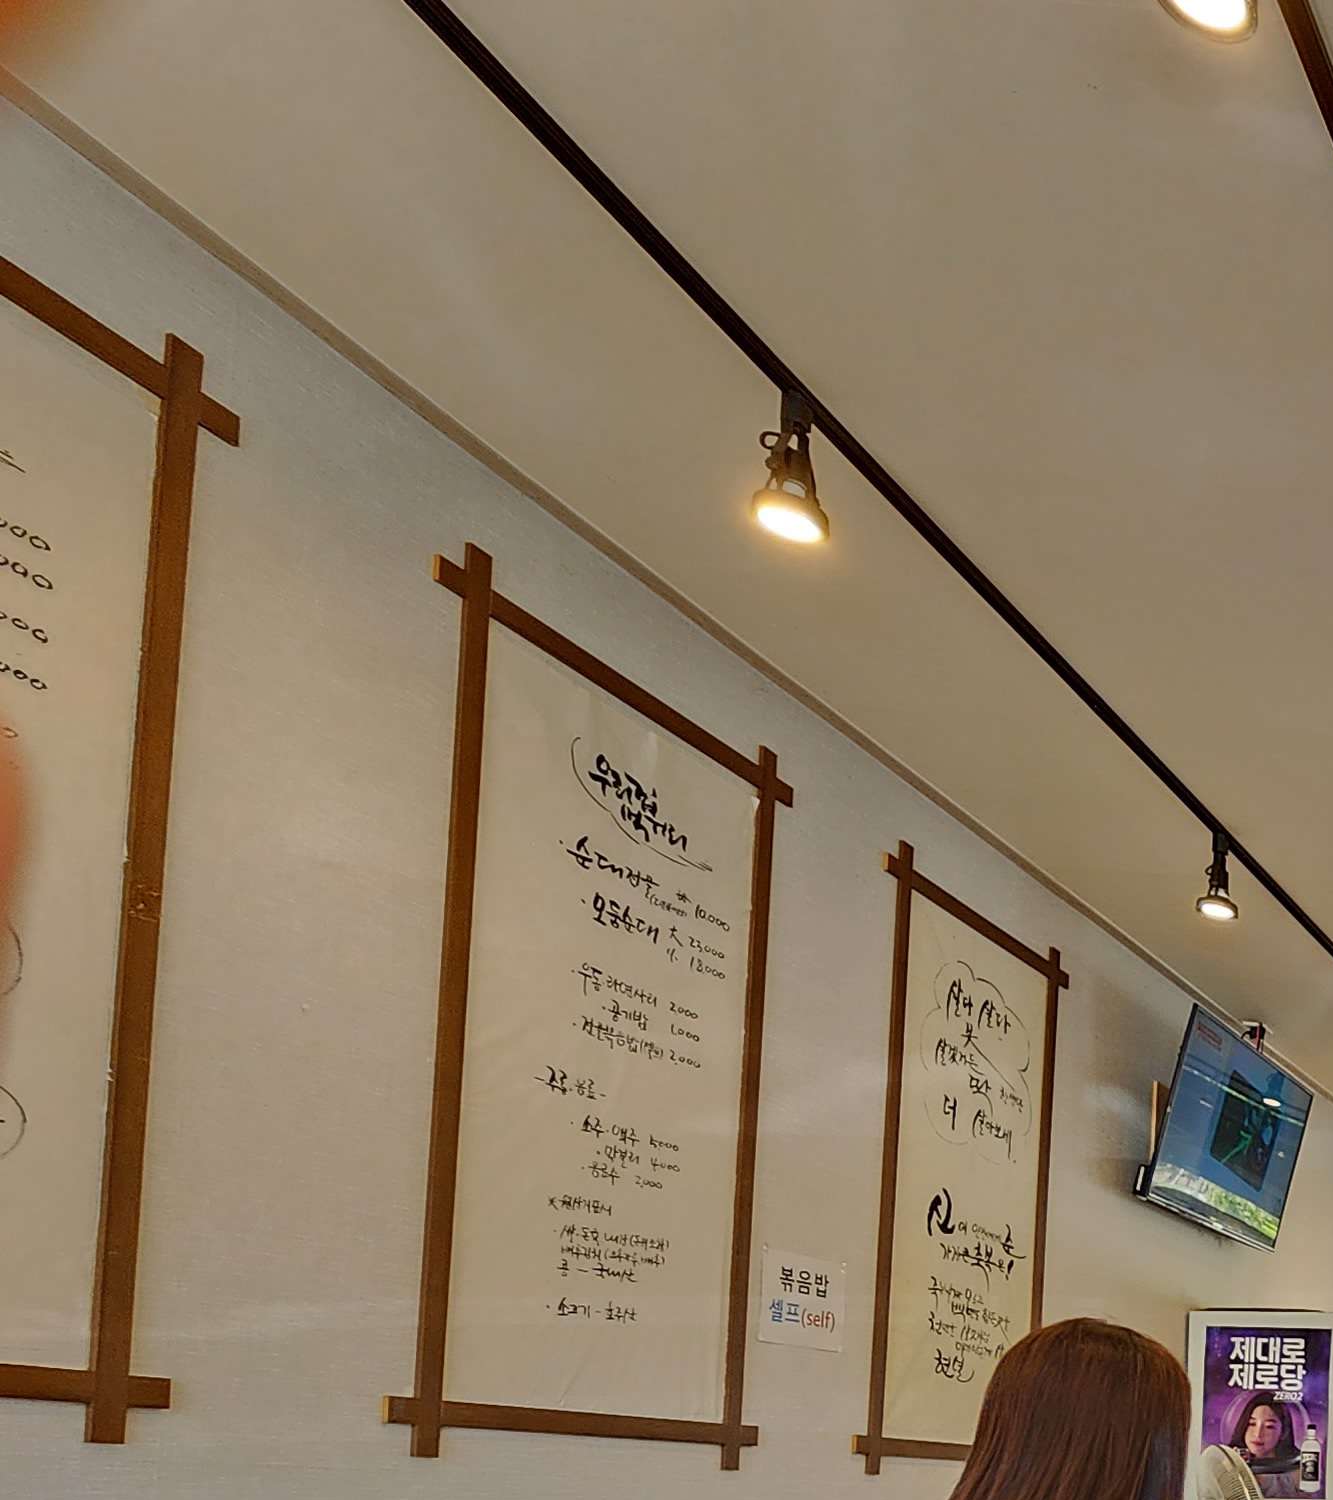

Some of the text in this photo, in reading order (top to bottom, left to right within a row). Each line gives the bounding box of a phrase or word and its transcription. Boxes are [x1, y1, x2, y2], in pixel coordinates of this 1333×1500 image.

[779, 1266, 830, 1298] 볶음밥
[1230, 1336, 1306, 1364] 제대로
[1228, 1364, 1307, 1391] 제로당
